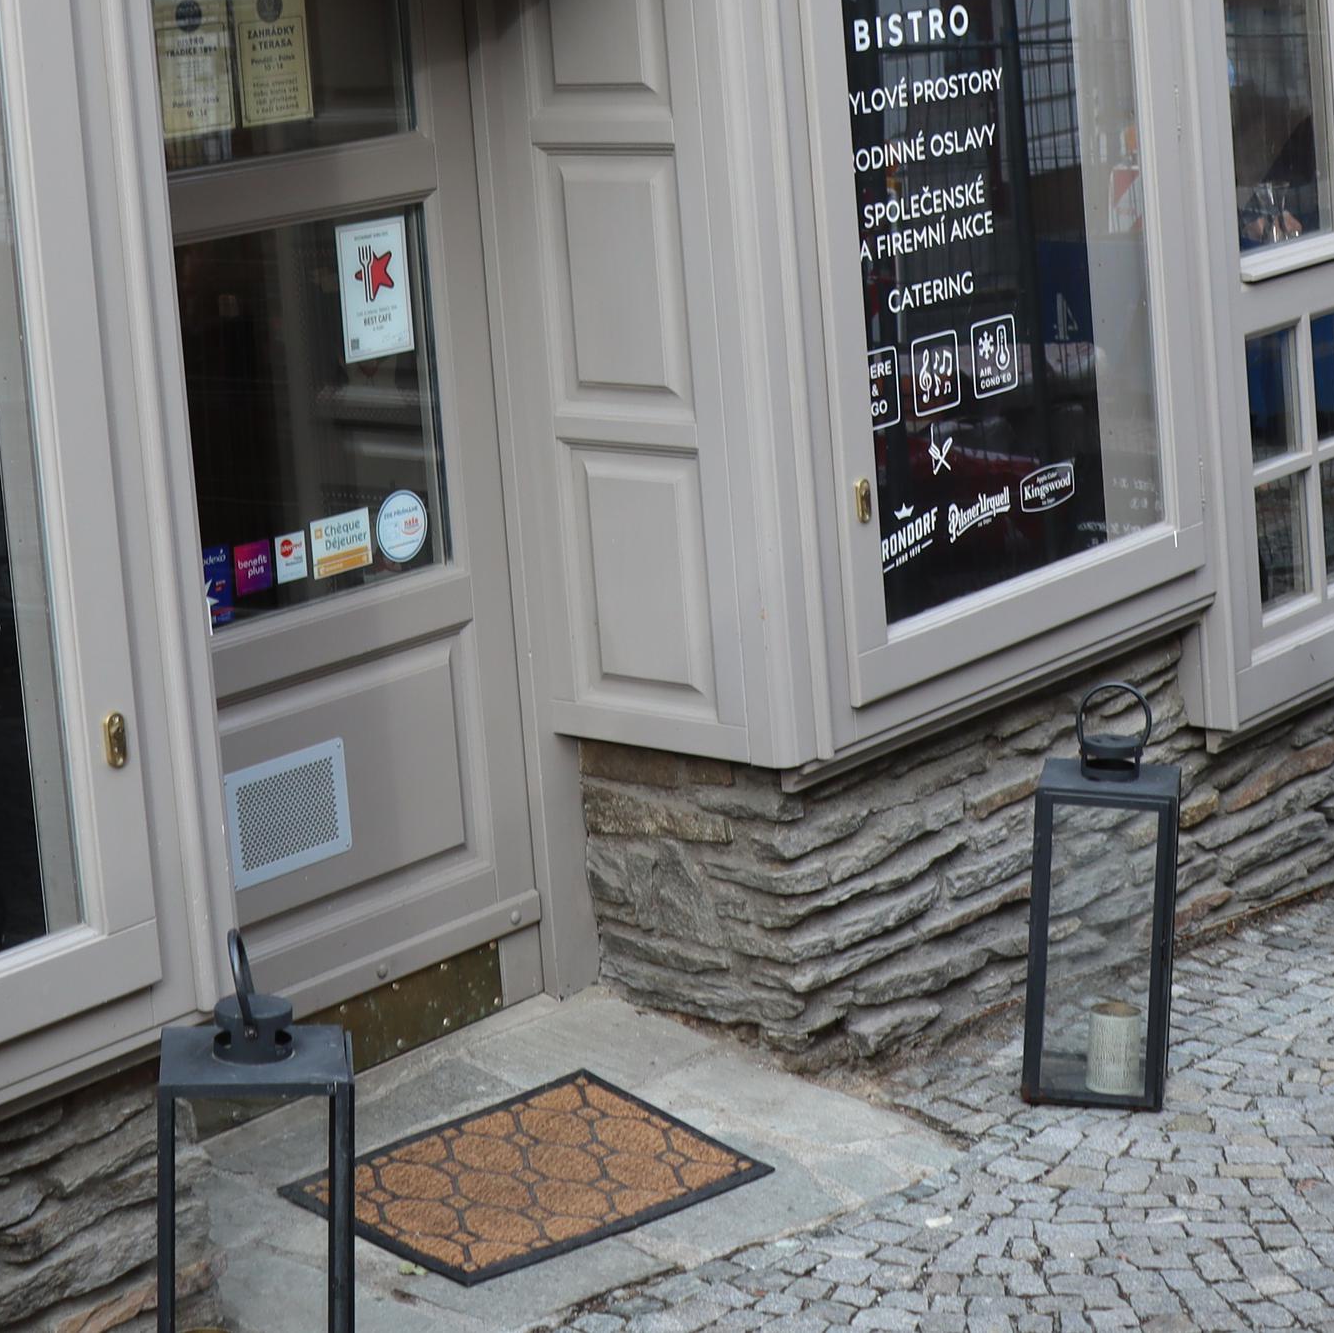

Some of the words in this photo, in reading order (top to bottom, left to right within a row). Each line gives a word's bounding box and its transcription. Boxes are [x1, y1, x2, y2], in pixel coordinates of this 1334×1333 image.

[853, 4, 969, 52] BISTRO
[913, 67, 1003, 108] PROSTORY
[930, 123, 996, 158] OSLAVY
[863, 173, 986, 229] SPOLEČENSKÉ
[860, 240, 872, 263] A
[876, 217, 946, 260] FIREMNÍ
[950, 211, 994, 241] AKCE
[888, 271, 974, 313] CATERING
[979, 368, 993, 378] AIR
[1024, 473, 1071, 501] Kingswood
[324, 519, 361, 537] Chèque
[325, 530, 367, 551] Déjeuner
[237, 554, 268, 570] benefit
[247, 566, 265, 579] plus
